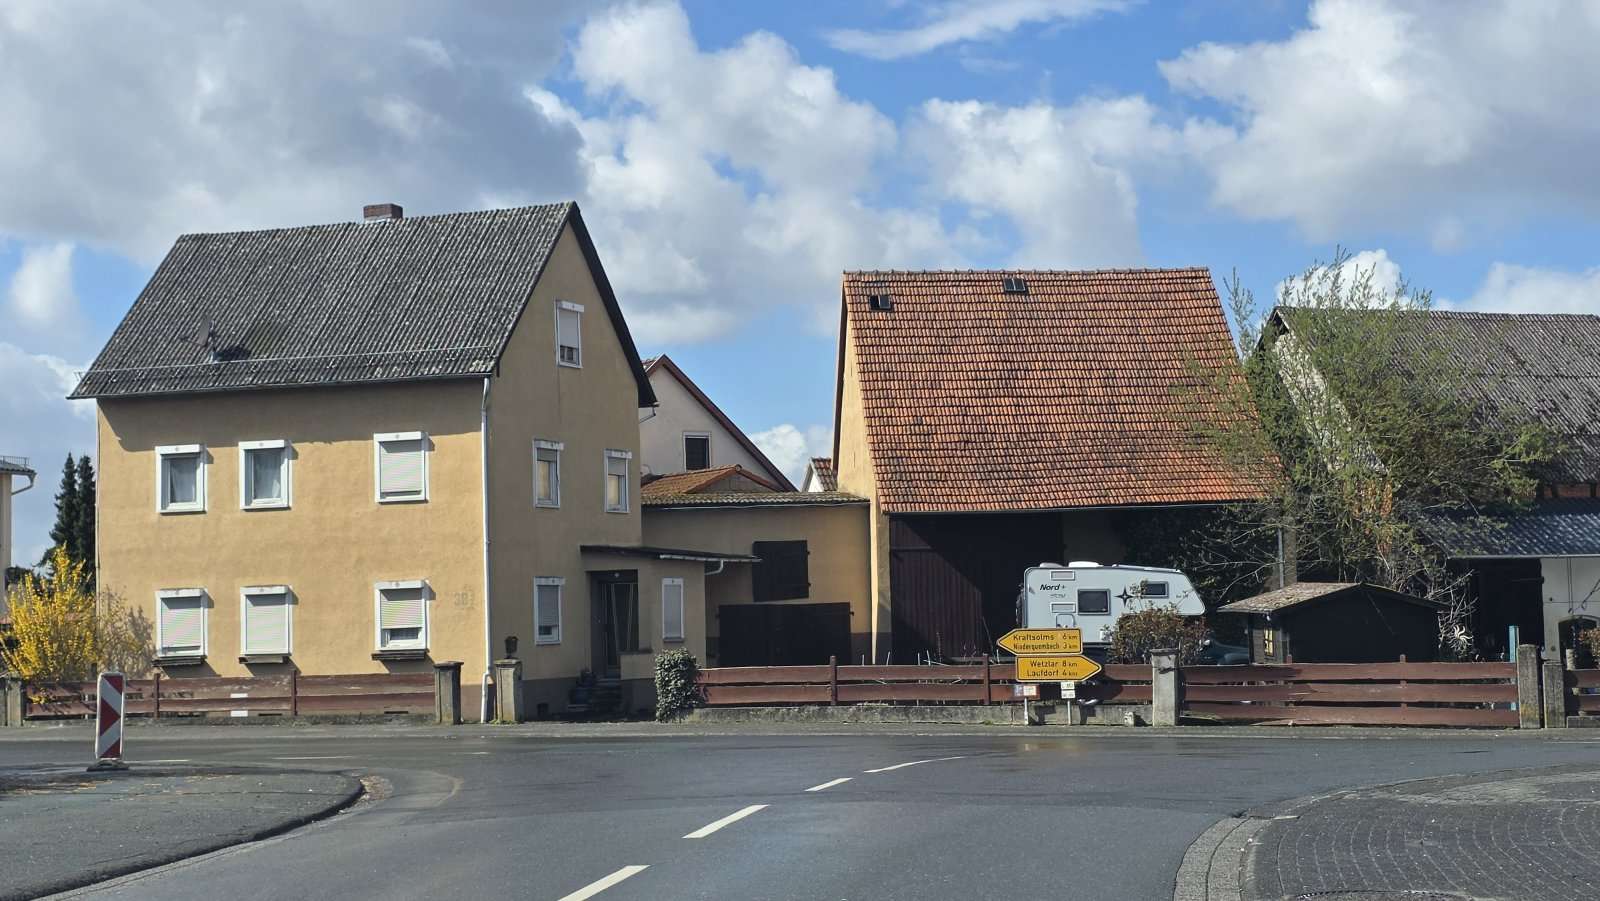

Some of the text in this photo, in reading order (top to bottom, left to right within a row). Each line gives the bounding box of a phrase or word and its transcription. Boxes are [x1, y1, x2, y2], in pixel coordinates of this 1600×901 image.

[1013, 633, 1055, 641] Kraftsolms
[1030, 660, 1059, 668] Wetzlar
[1027, 669, 1059, 677] Laufdorf
[1062, 669, 1067, 677] 4
